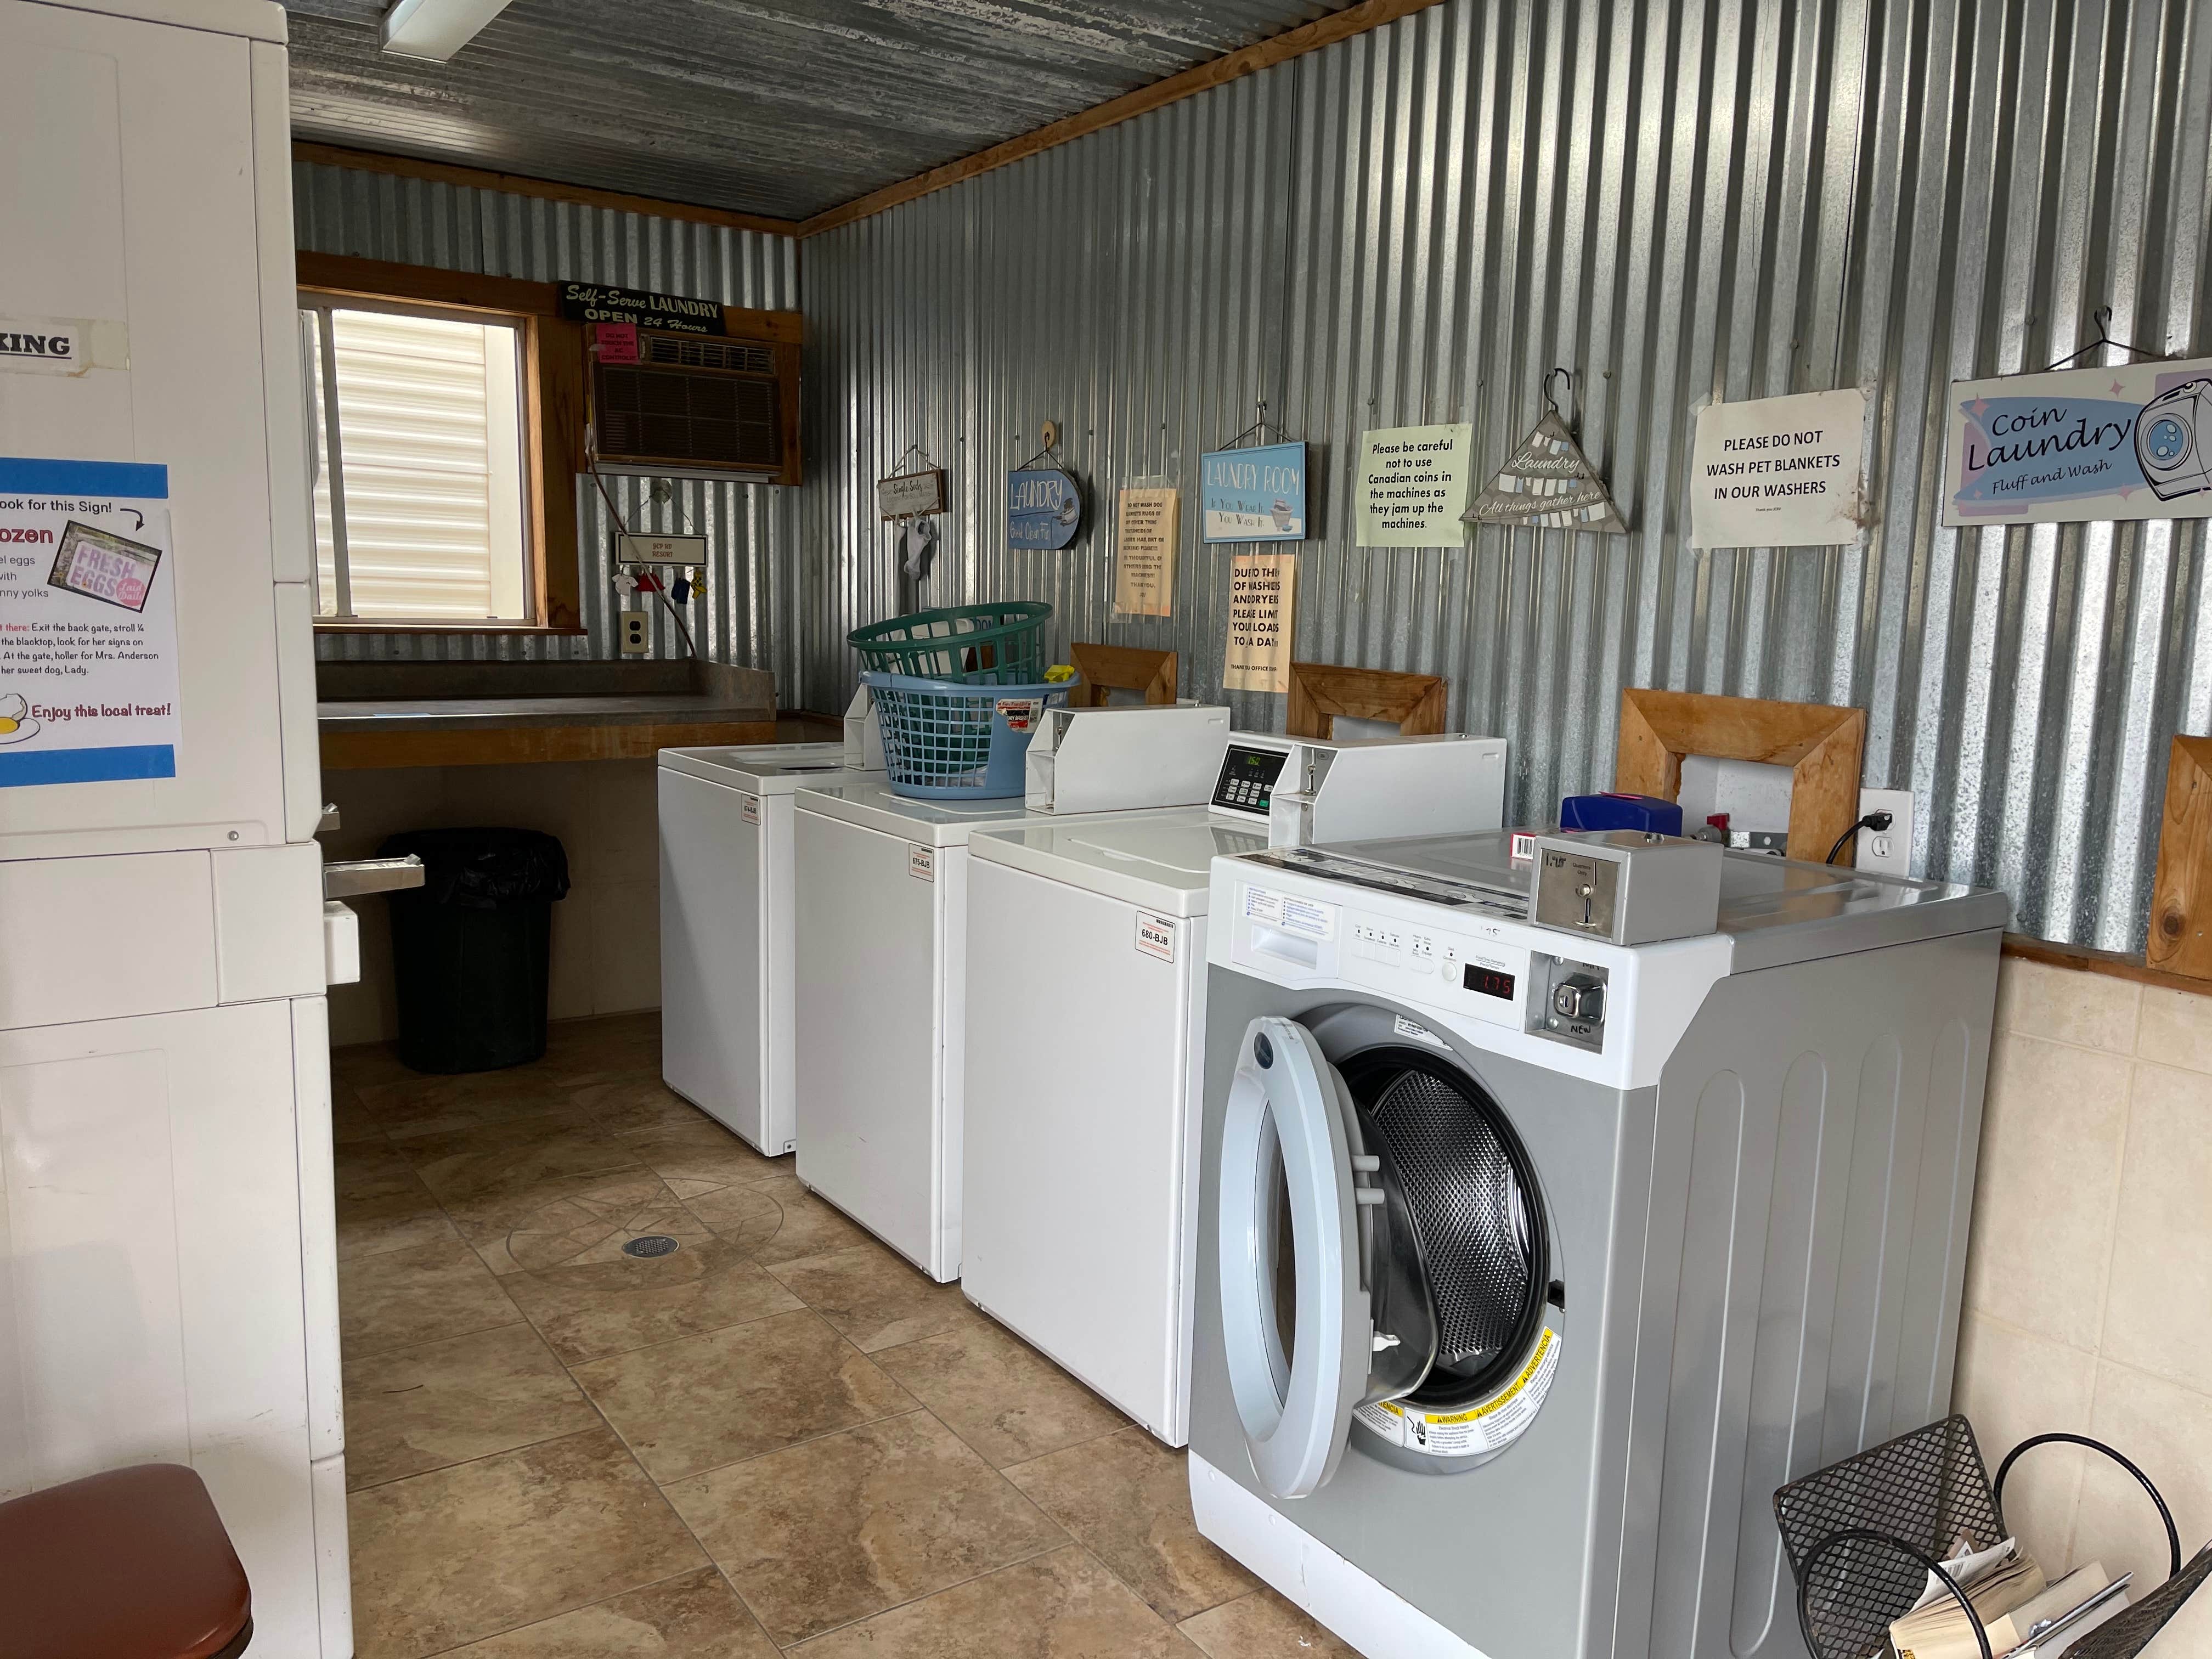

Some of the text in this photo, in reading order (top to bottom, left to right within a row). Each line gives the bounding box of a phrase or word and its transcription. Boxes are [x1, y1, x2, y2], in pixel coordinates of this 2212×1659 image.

[566, 285, 718, 318] Self-Serve LAUNDRY
[584, 308, 708, 332] OPEN 24 Hours
[1992, 407, 2067, 436] Coin
[1373, 439, 1453, 454] Please be careful
[1724, 430, 1823, 452] PLEASE DO NOT
[1968, 417, 2132, 471] Laundry
[1386, 458, 1432, 468] not to use
[1511, 452, 1581, 473] Laundry
[1707, 454, 1840, 476] WASH PET BLANKETS
[1207, 461, 1300, 495] LAUNDRY ROOM
[1368, 471, 1452, 484] Canadian coins in
[1992, 459, 2113, 495] Fluff and Wash
[894, 482, 908, 497] Single
[1010, 479, 1063, 510] LAUNDRY
[1370, 488, 1384, 499] the
[1386, 487, 1431, 499] machines
[1714, 481, 1826, 500] IN OUR WASHERS
[28, 499, 46, 510] for
[50, 500, 75, 511] this
[78, 501, 112, 515] Sign!
[1370, 501, 1443, 517] they jam up the
[1479, 491, 1601, 516] All things gather here
[1382, 518, 1427, 528] machines.
[10, 557, 36, 567] eggs
[76, 547, 137, 578] FRESH
[1235, 568, 1251, 577] DUE
[70, 566, 117, 597] EGGS
[1234, 582, 1246, 590] OF
[21, 589, 49, 599] yolks
[1233, 595, 1279, 604] AND DRYERS
[1233, 609, 1256, 618] PLEASE
[5, 623, 29, 631] there:
[53, 623, 65, 631] the
[68, 623, 89, 631] back
[91, 624, 112, 634] gate,
[1253, 623, 1279, 632] LOADS
[16, 637, 55, 648] blacktop,
[57, 637, 76, 646] look
[93, 637, 106, 646] her
[108, 638, 131, 647] signs
[1234, 636, 1245, 645] TO
[32, 652, 53, 662] gate,
[1, 666, 15, 674] her
[44, 666, 63, 675] dog,
[65, 666, 89, 676] Lady.
[31, 703, 171, 722] Enjoy this local treat!
[1142, 929, 1168, 945] 680-BJB
[1570, 1025, 1591, 1034] NEW
[1526, 1335, 1550, 1377] ADVERTENCIA
[1482, 1383, 1521, 1415] AVERTISSEMENT
[1442, 1414, 1468, 1423] WARNING
